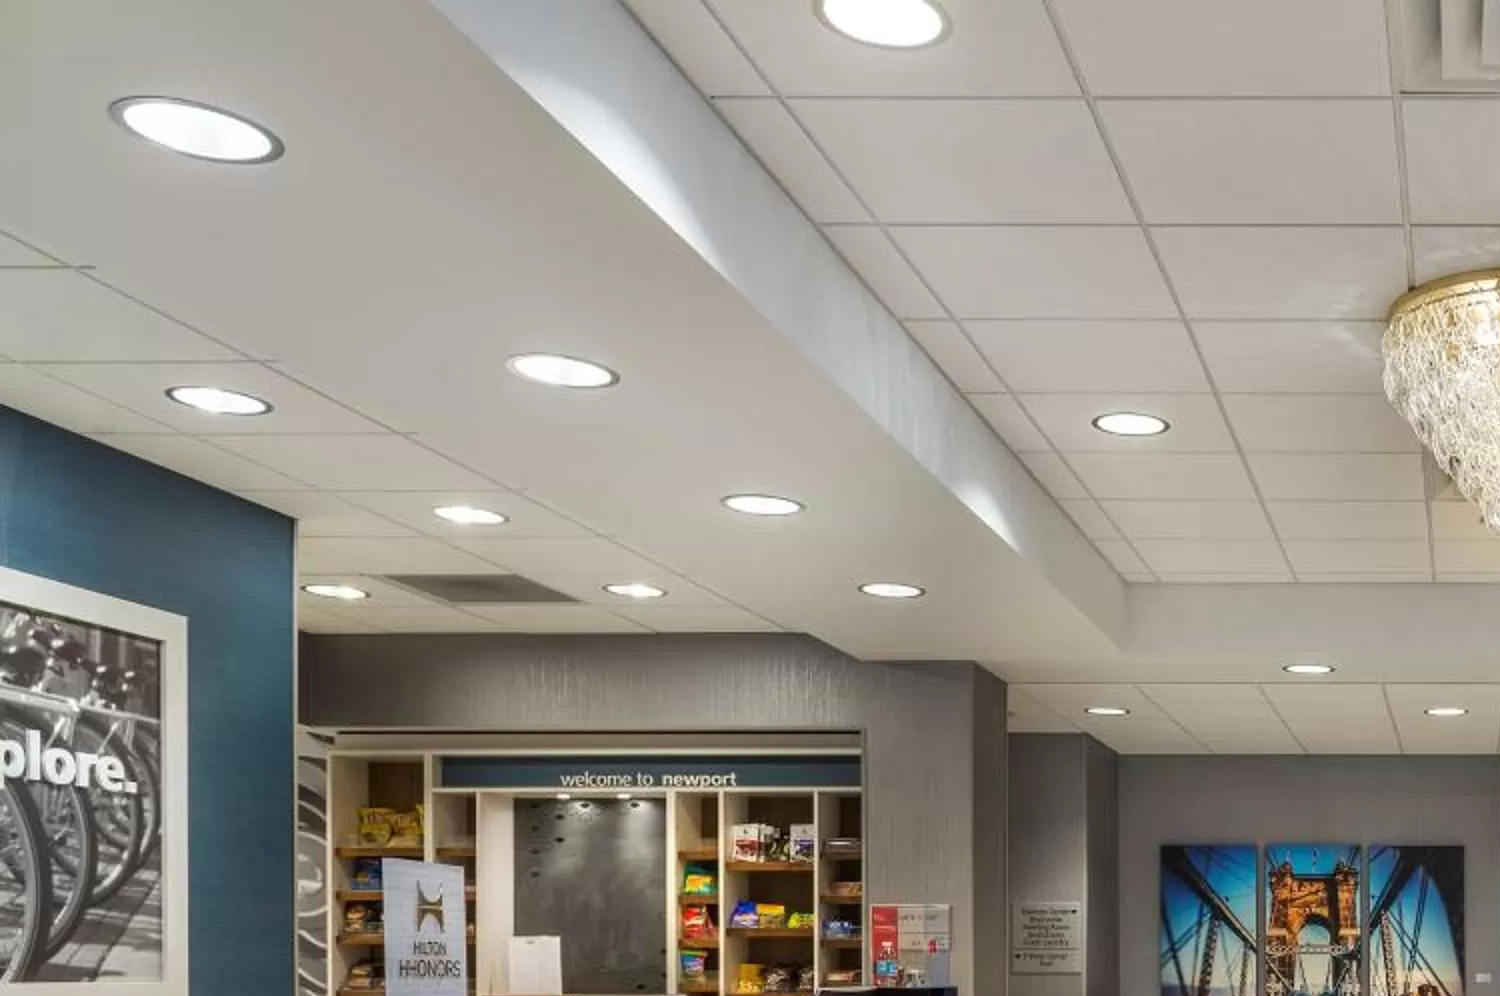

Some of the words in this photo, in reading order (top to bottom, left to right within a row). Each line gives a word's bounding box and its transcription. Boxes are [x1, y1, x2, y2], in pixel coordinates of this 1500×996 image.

[560, 771, 632, 787] welcome
[637, 772, 653, 787] to
[661, 771, 737, 788] newport
[413, 940, 447, 955] HILTON
[399, 959, 461, 977] HHONORS
